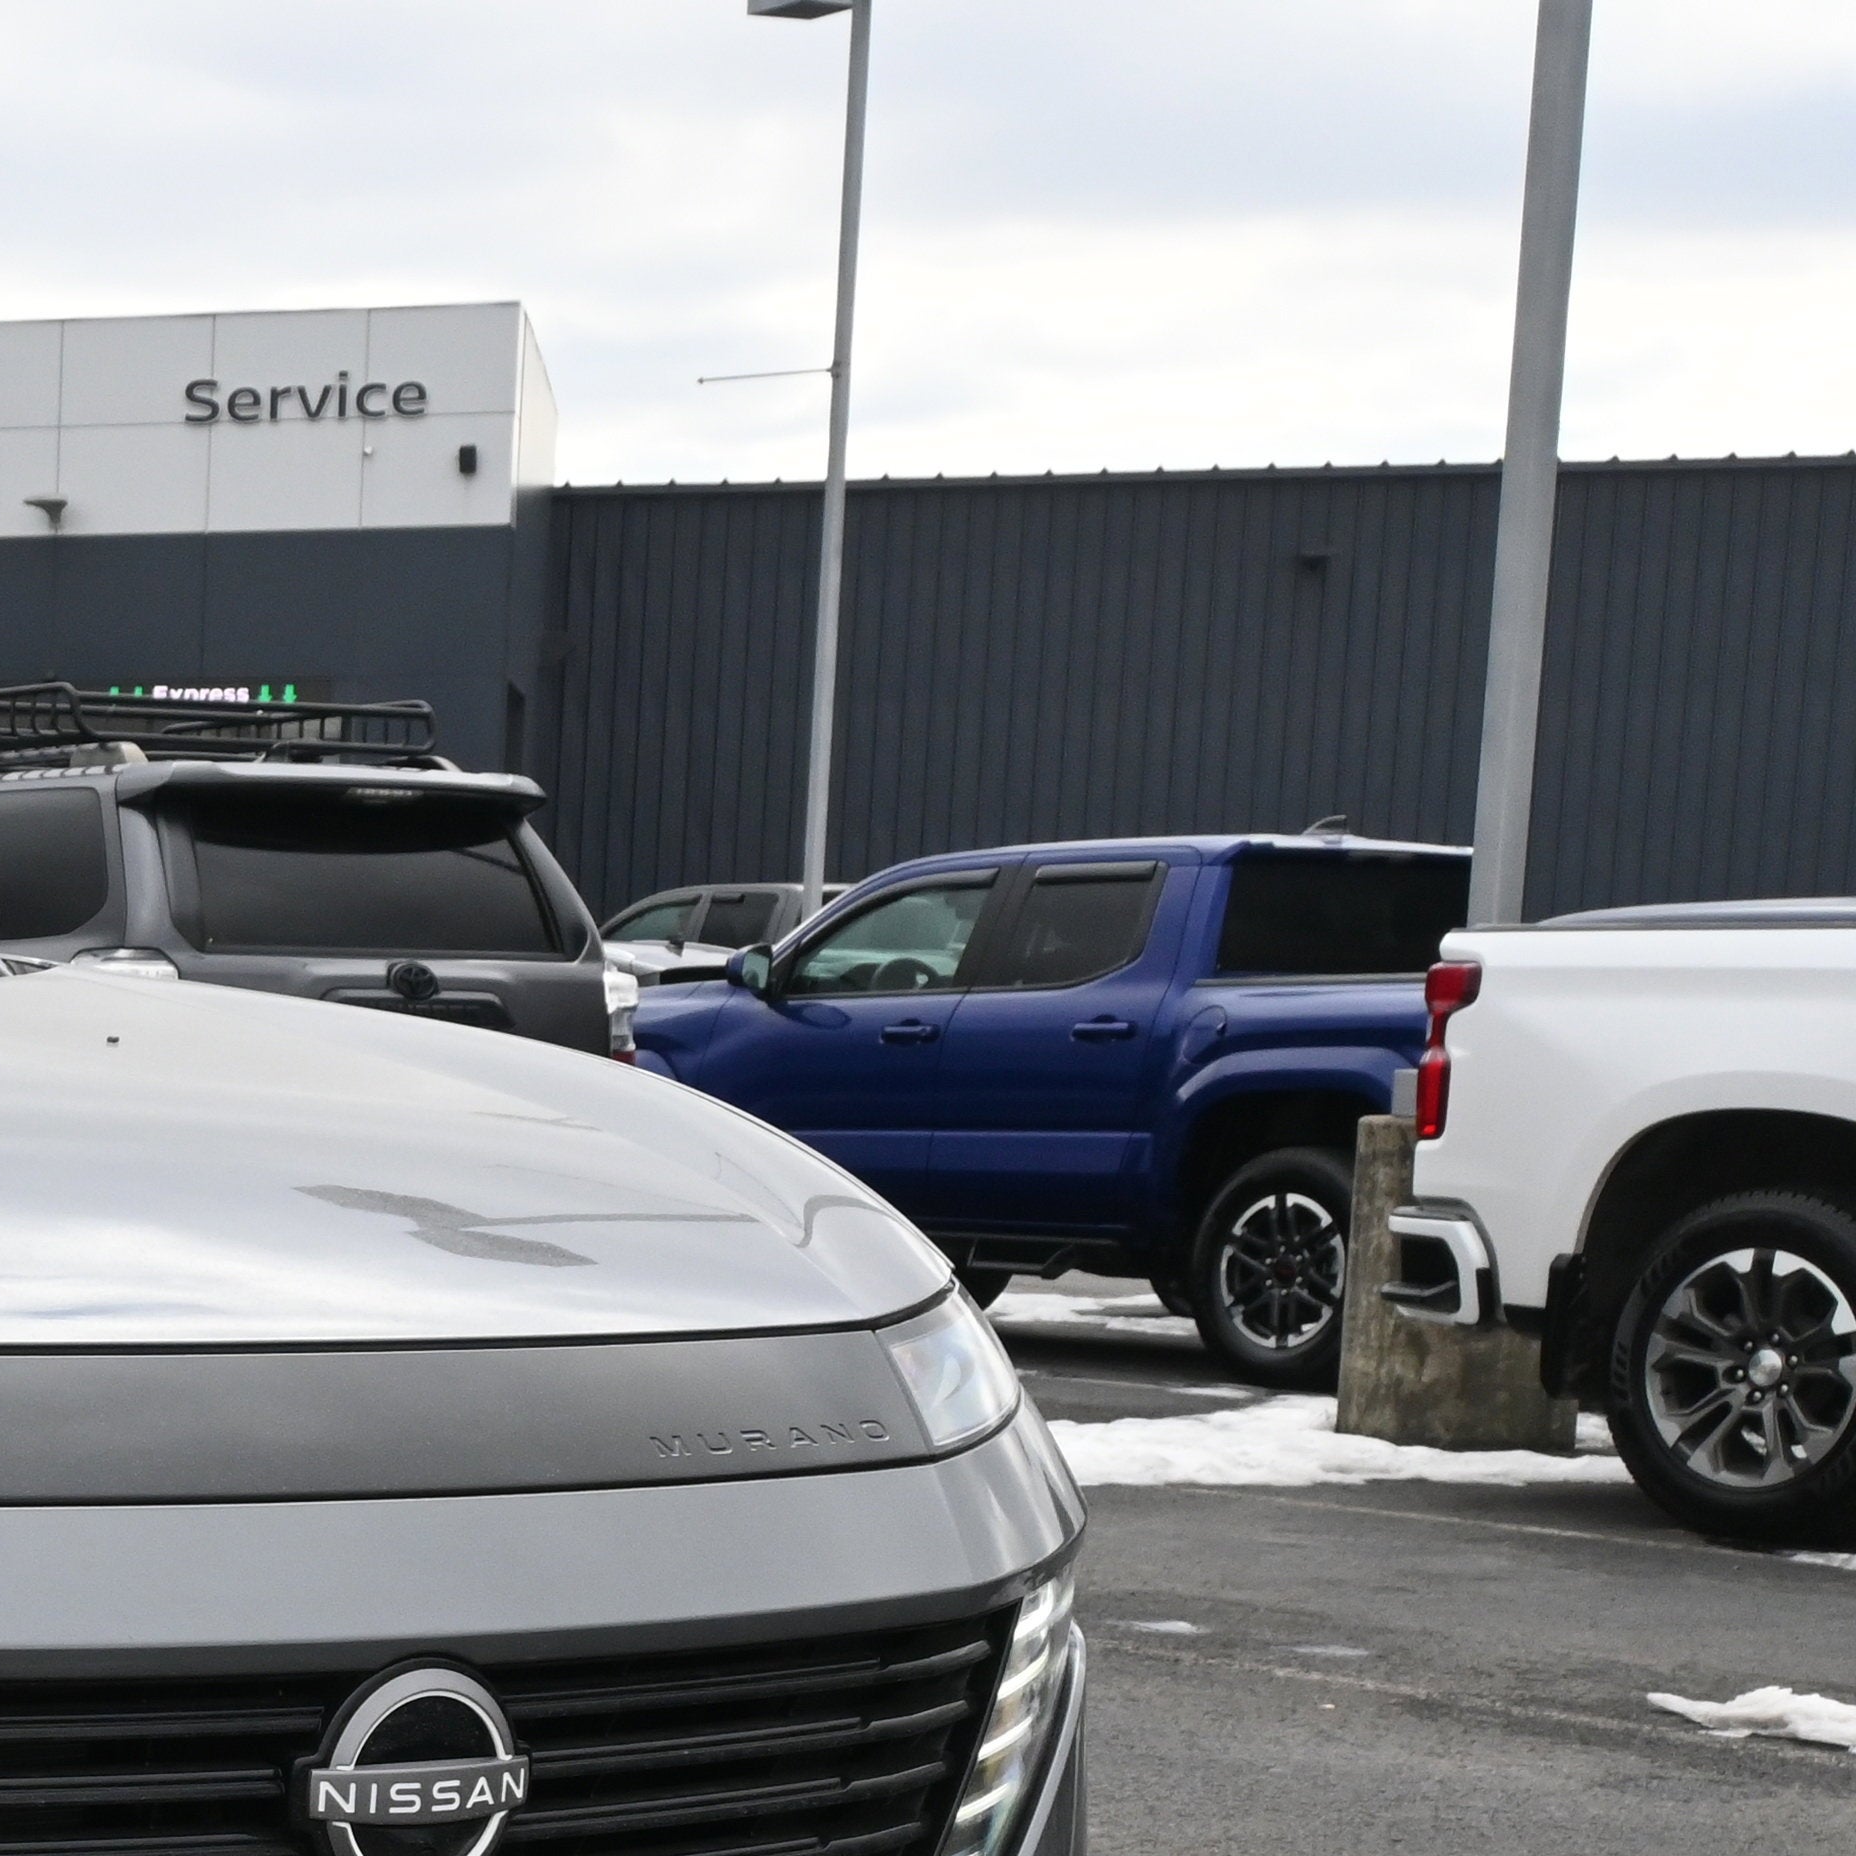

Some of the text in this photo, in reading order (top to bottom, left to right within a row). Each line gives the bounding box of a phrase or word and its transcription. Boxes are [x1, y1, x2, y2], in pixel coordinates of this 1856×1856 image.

[185, 370, 427, 422] Service
[649, 1420, 890, 1458] MURANO
[318, 1768, 525, 1814] NISSAN
